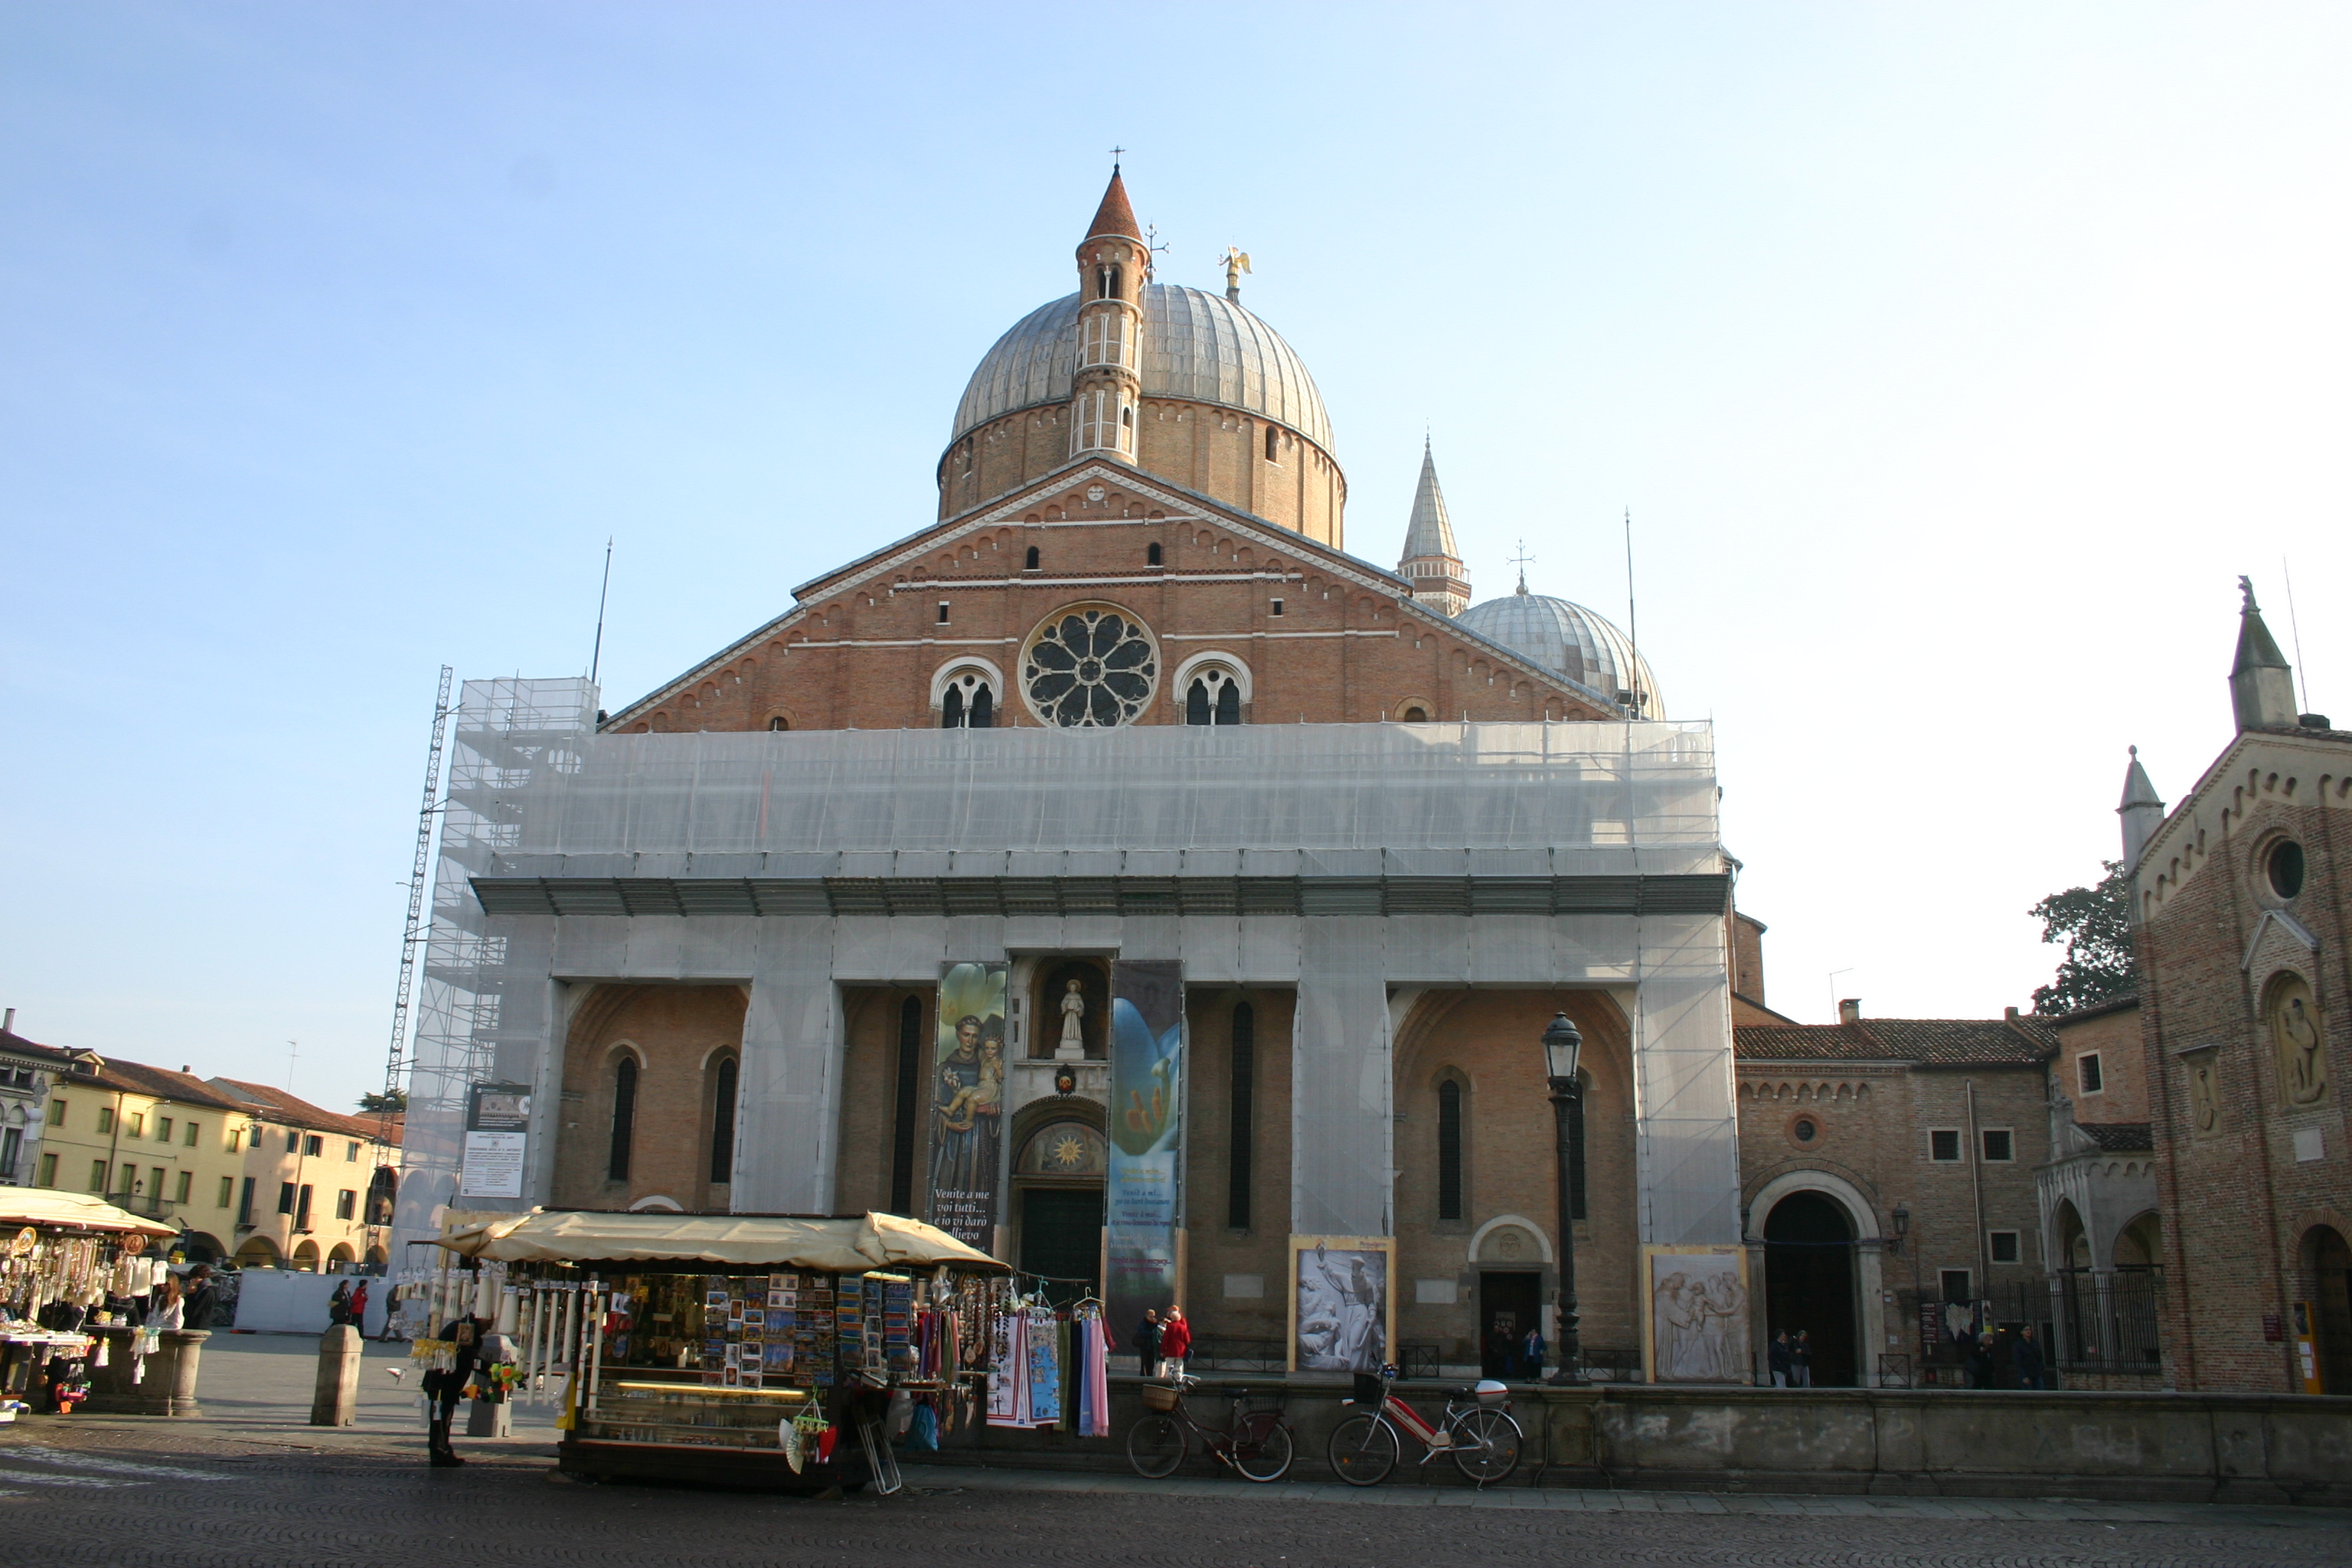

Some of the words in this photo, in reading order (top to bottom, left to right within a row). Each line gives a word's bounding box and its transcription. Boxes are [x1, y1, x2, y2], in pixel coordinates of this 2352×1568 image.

[935, 1187, 965, 1199] Venite
[937, 1201, 952, 1212] voi
[955, 1201, 985, 1213] tutti...
[942, 1214, 950, 1225] io
[952, 1215, 963, 1226] vi
[965, 1215, 987, 1227] darò
[947, 1227, 979, 1240] llievo
